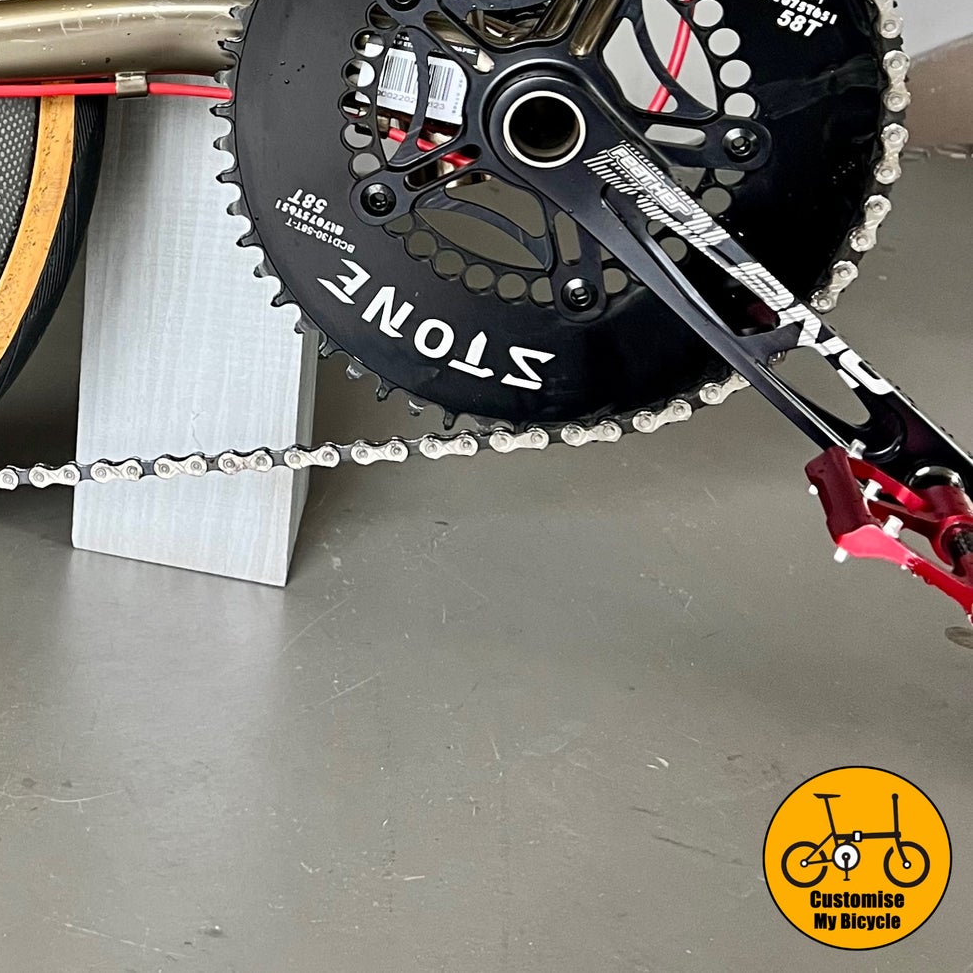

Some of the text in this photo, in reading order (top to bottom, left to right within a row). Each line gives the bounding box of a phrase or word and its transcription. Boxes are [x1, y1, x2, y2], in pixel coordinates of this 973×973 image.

[776, 9, 824, 37] 58T
[287, 188, 328, 214] 58T
[317, 258, 557, 391] STONE
